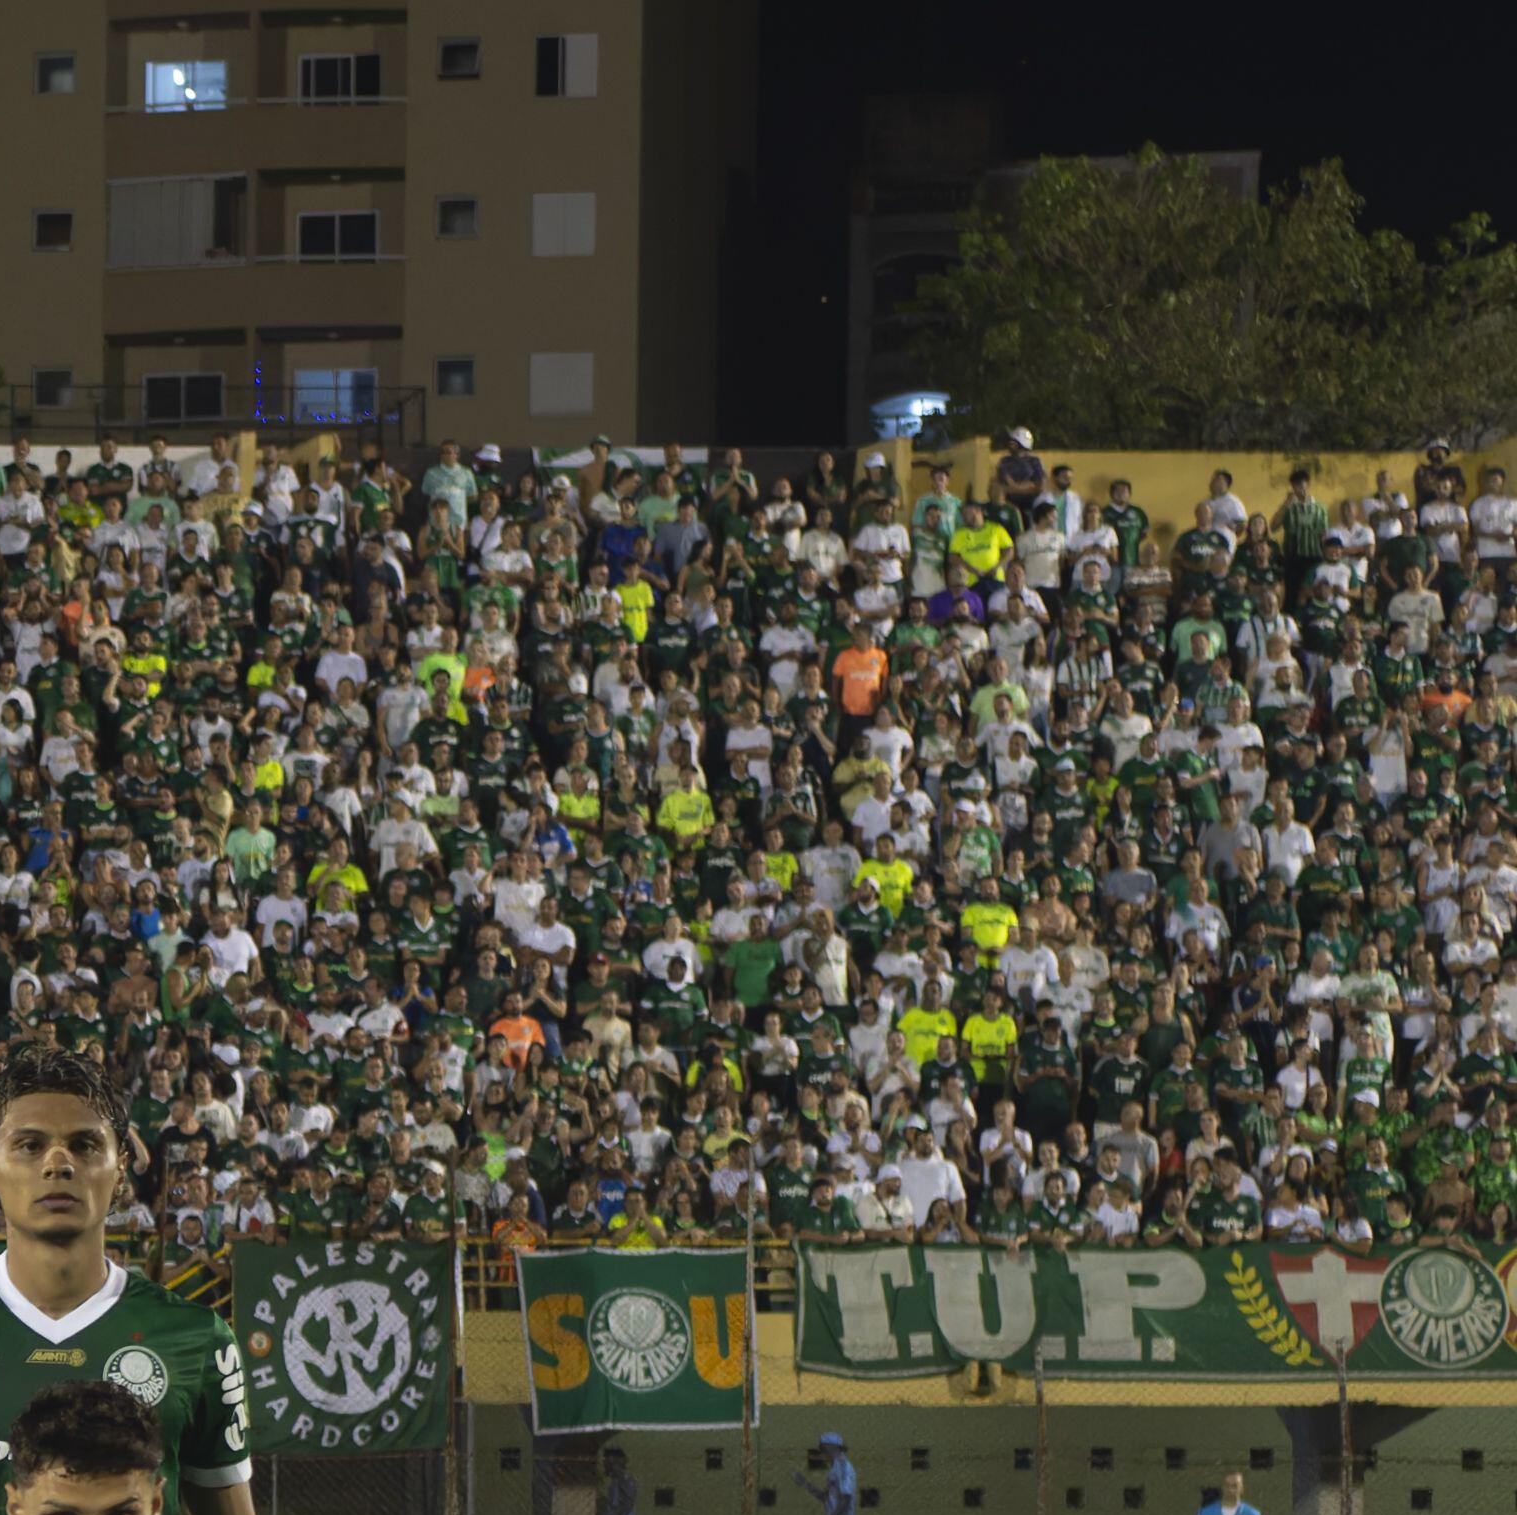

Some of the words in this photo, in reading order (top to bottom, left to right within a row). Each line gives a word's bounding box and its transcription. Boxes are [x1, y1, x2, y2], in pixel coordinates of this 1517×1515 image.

[254, 1241, 438, 1325] PALESTRA
[1386, 1296, 1505, 1365] PALMEIRAS
[251, 1359, 437, 1448] HARDCORE
